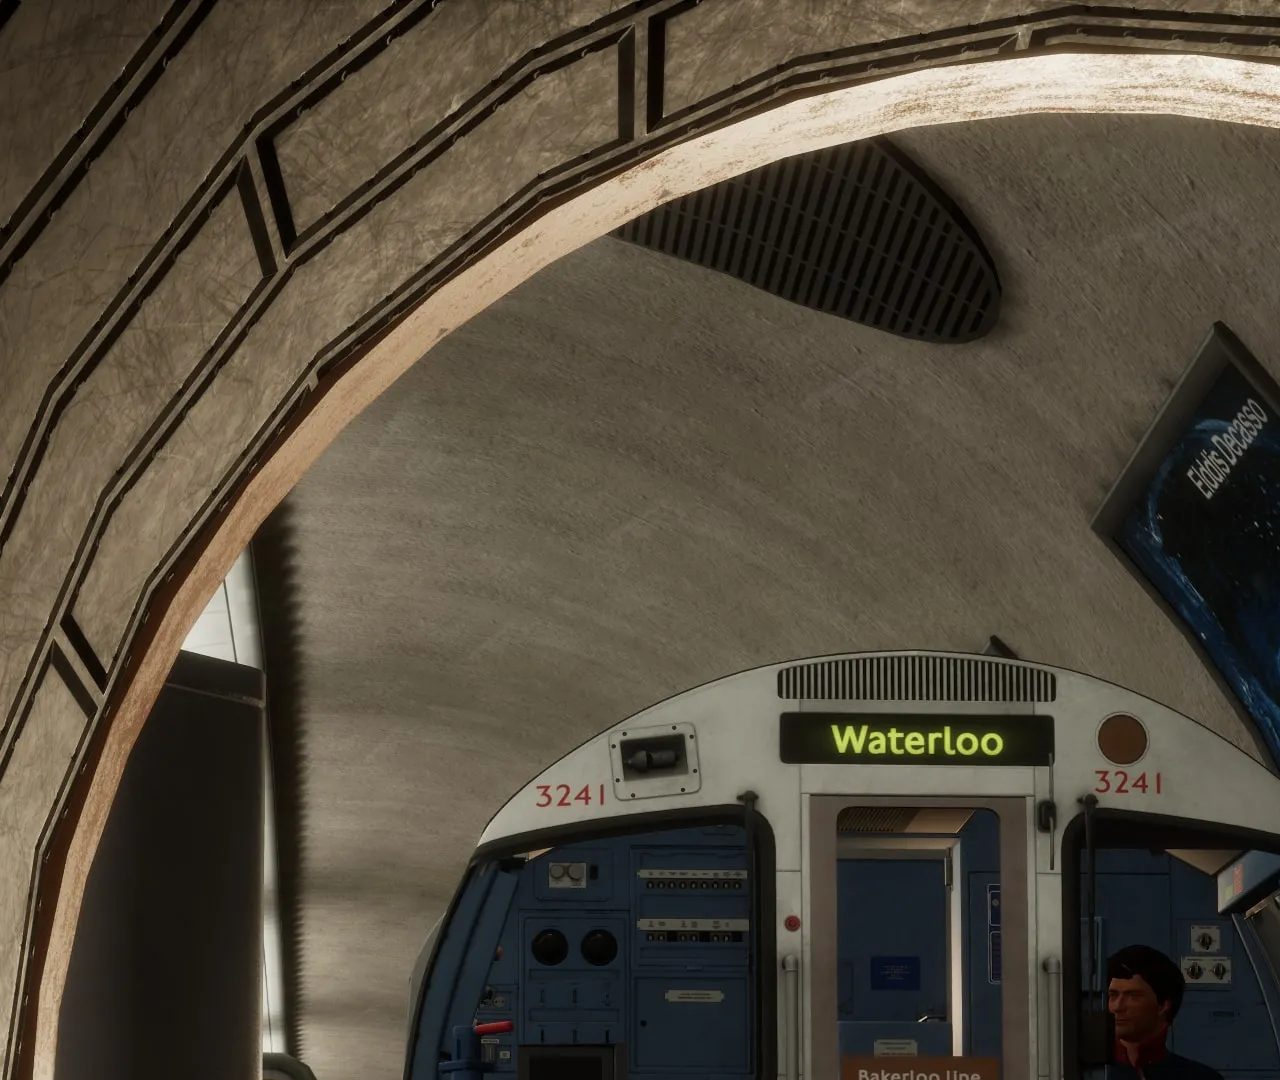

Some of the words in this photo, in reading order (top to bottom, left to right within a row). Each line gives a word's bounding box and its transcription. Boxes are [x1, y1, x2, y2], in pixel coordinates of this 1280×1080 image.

[1186, 448, 1231, 500] Elddis
[1210, 398, 1268, 466] Decasso
[831, 724, 1004, 756] Waterloo
[536, 783, 606, 808] 3241
[1095, 770, 1163, 795] 3241
